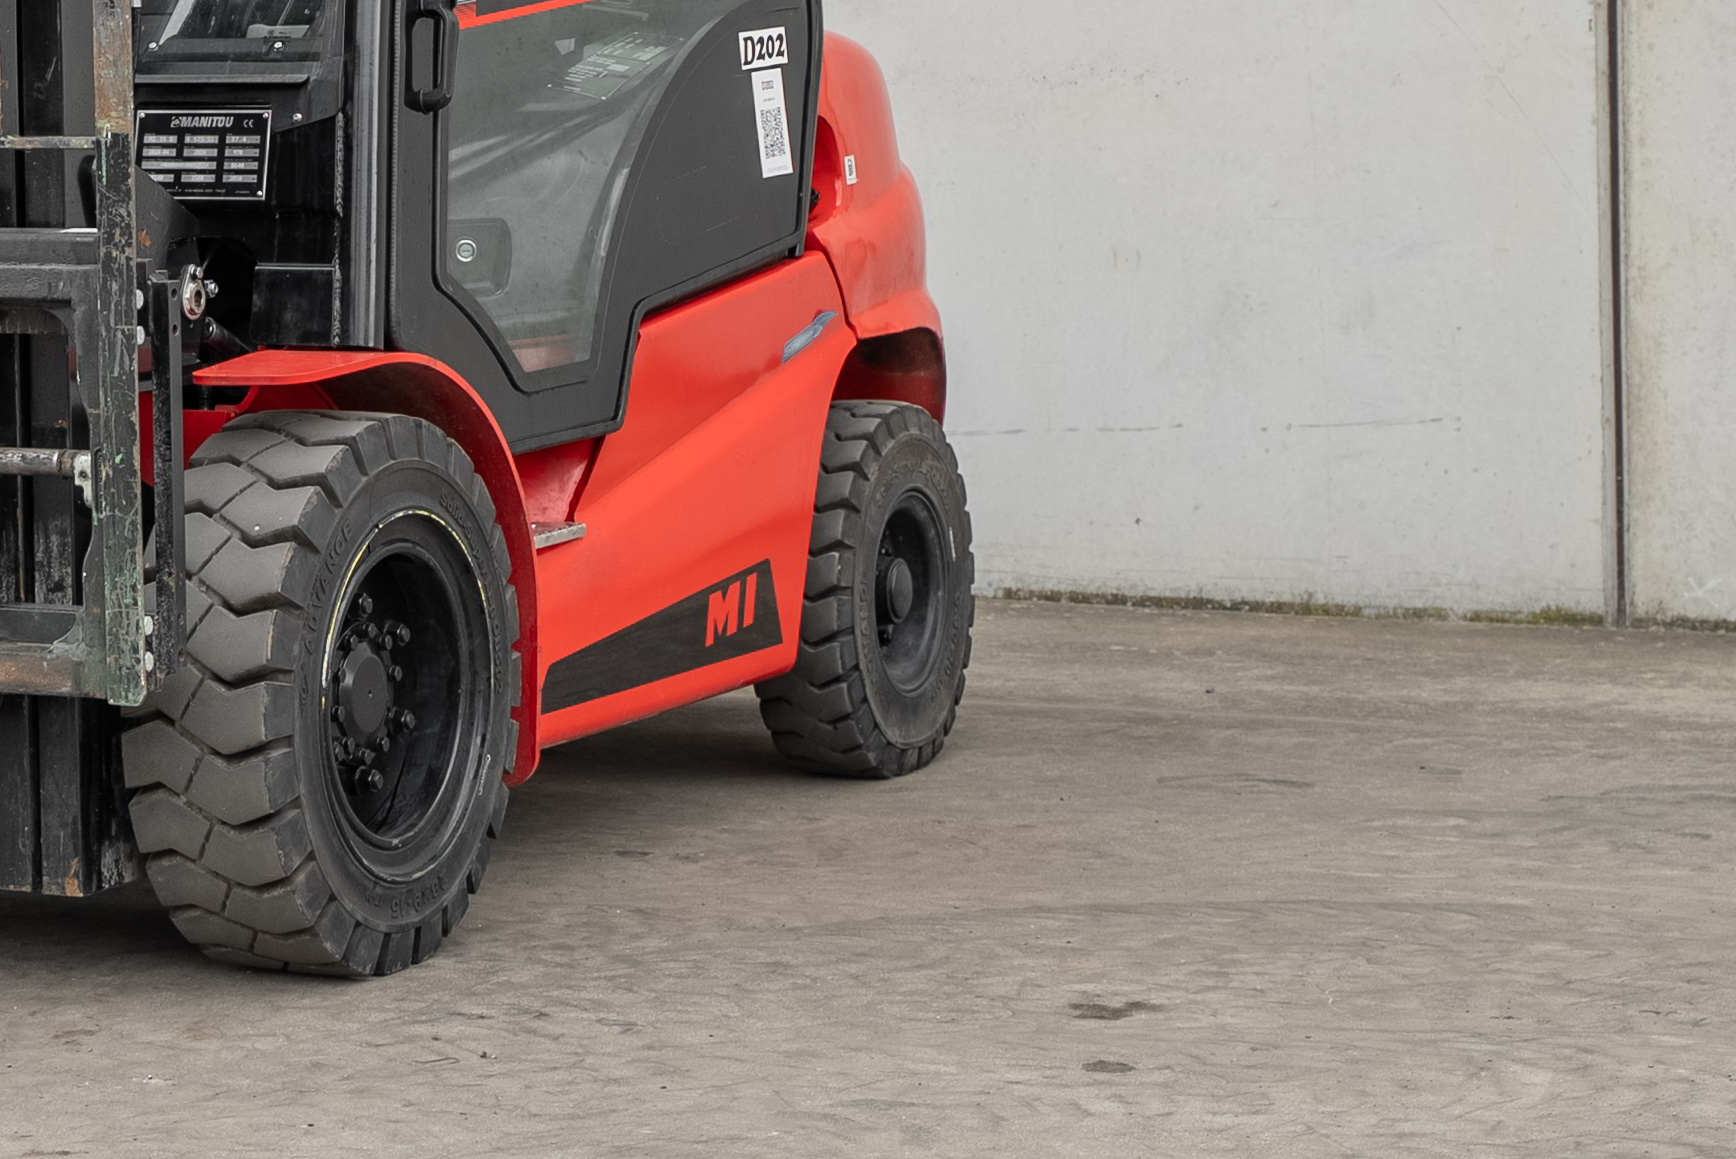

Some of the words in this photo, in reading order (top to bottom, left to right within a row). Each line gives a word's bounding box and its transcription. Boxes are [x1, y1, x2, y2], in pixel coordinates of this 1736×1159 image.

[742, 33, 785, 66] D202
[180, 116, 234, 128] MANITOU
[705, 572, 758, 648] MI
